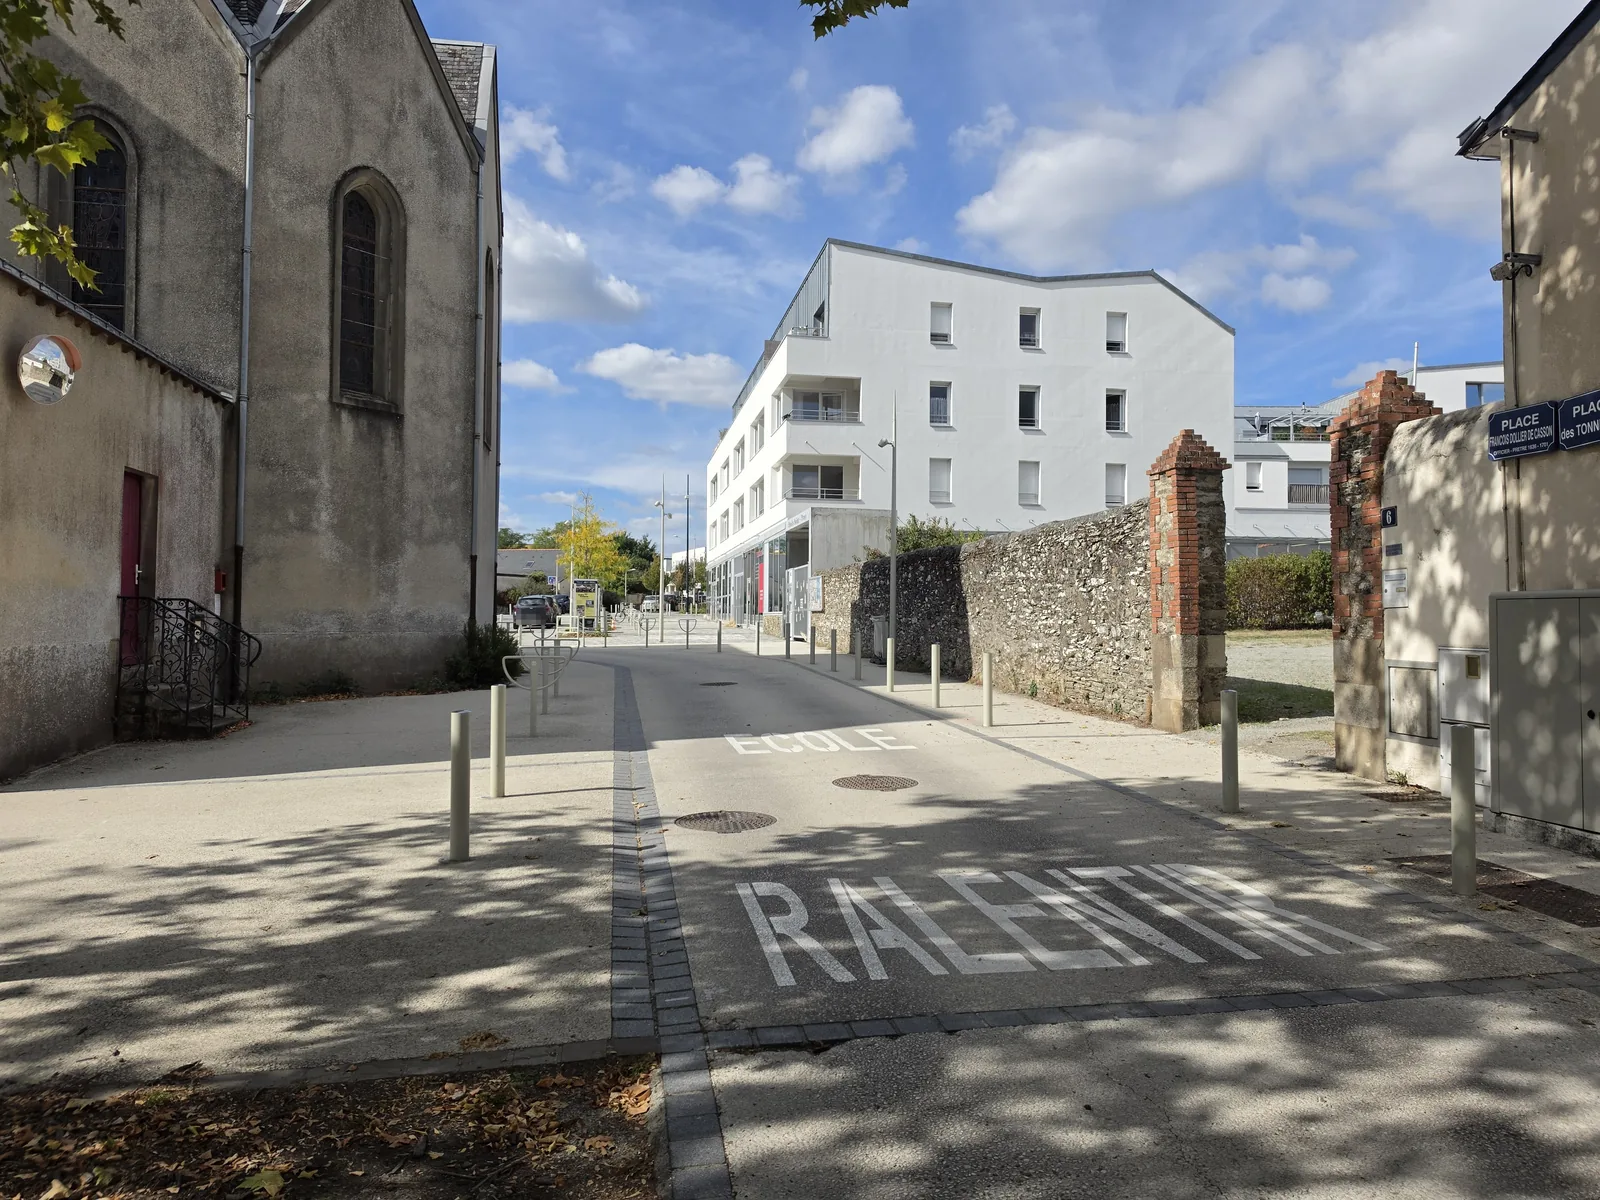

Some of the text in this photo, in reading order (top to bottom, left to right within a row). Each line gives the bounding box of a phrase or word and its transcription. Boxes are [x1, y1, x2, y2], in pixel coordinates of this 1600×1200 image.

[1501, 412, 1540, 432] PLACE
[1560, 419, 1600, 440] des TONN
[1534, 425, 1553, 440] CASSON
[1386, 510, 1392, 524] 6
[724, 728, 919, 755] ECOLE
[735, 863, 1391, 986] RALENTIR
